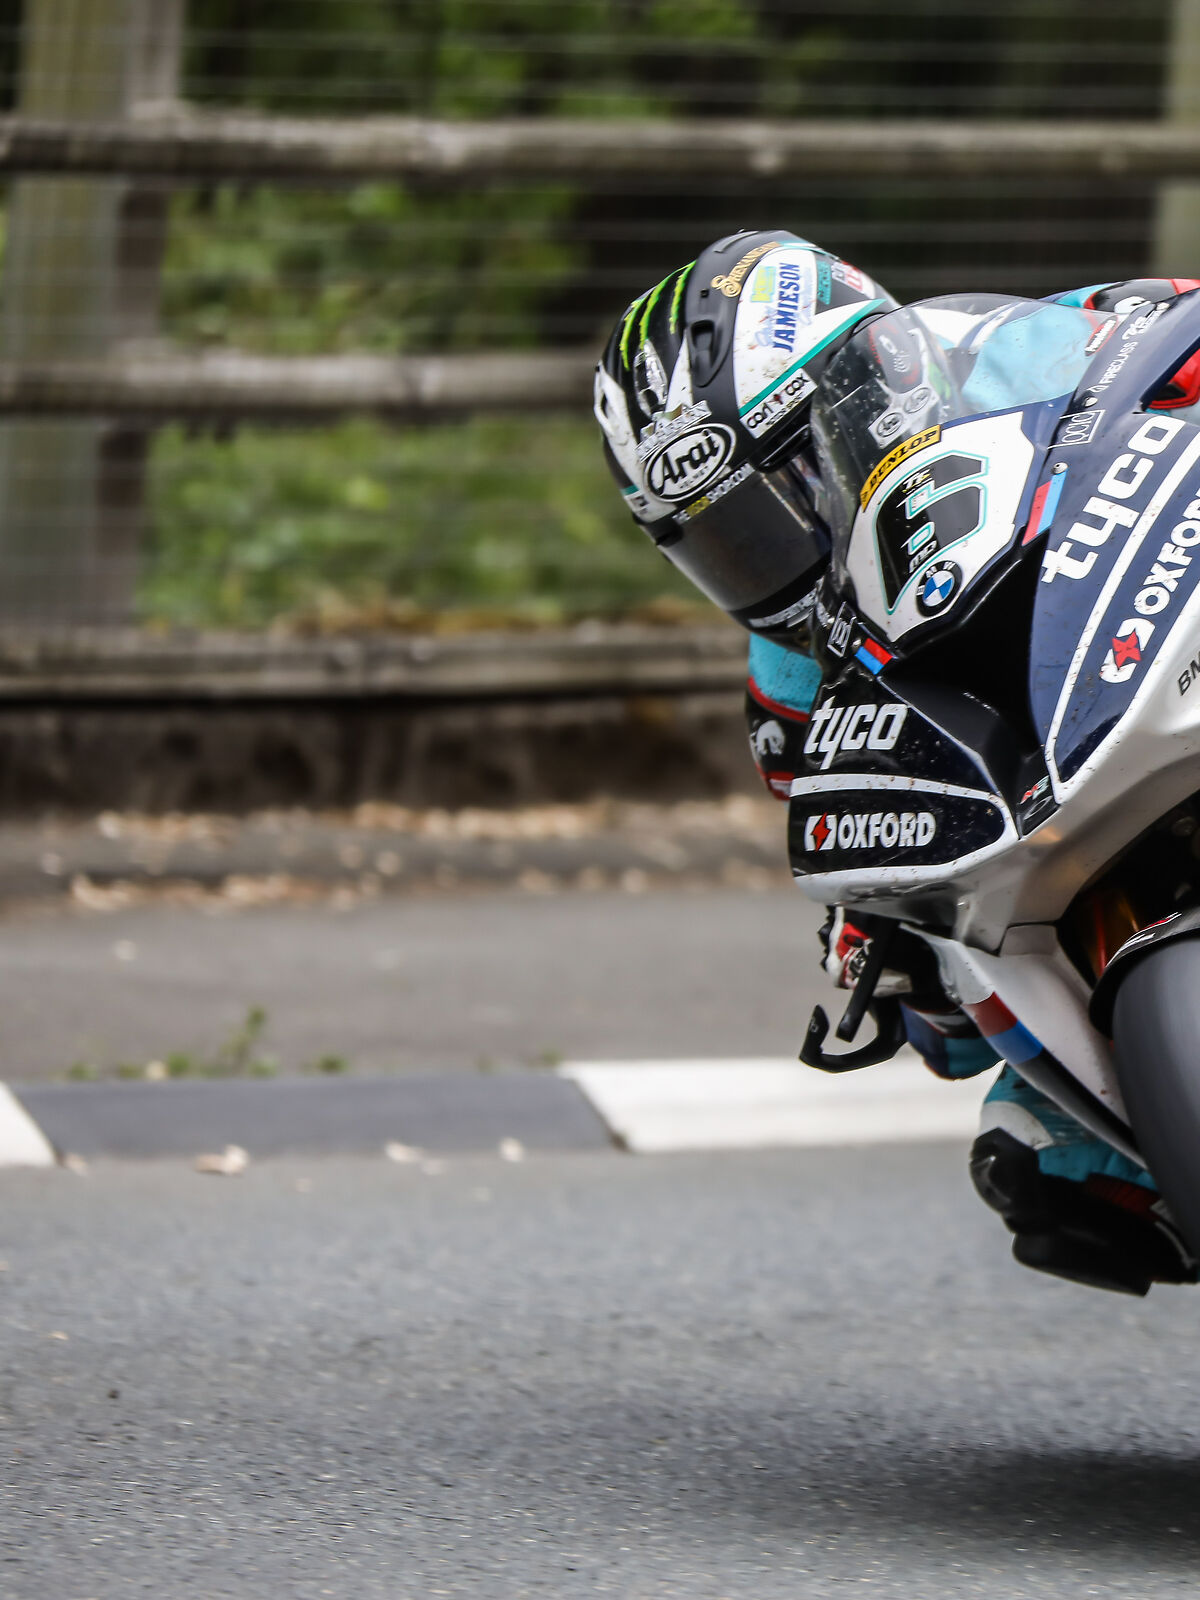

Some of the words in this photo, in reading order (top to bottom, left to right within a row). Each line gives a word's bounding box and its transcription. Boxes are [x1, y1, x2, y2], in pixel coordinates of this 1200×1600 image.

[772, 262, 800, 352] JAMIESON
[784, 374, 810, 396] cox
[1099, 341, 1138, 388] FIRECLASS
[652, 428, 719, 496] Arai
[869, 430, 938, 488] DUNLOP
[1041, 415, 1186, 583] tyco
[804, 696, 908, 770] tyco
[837, 812, 936, 849] OXFORD
